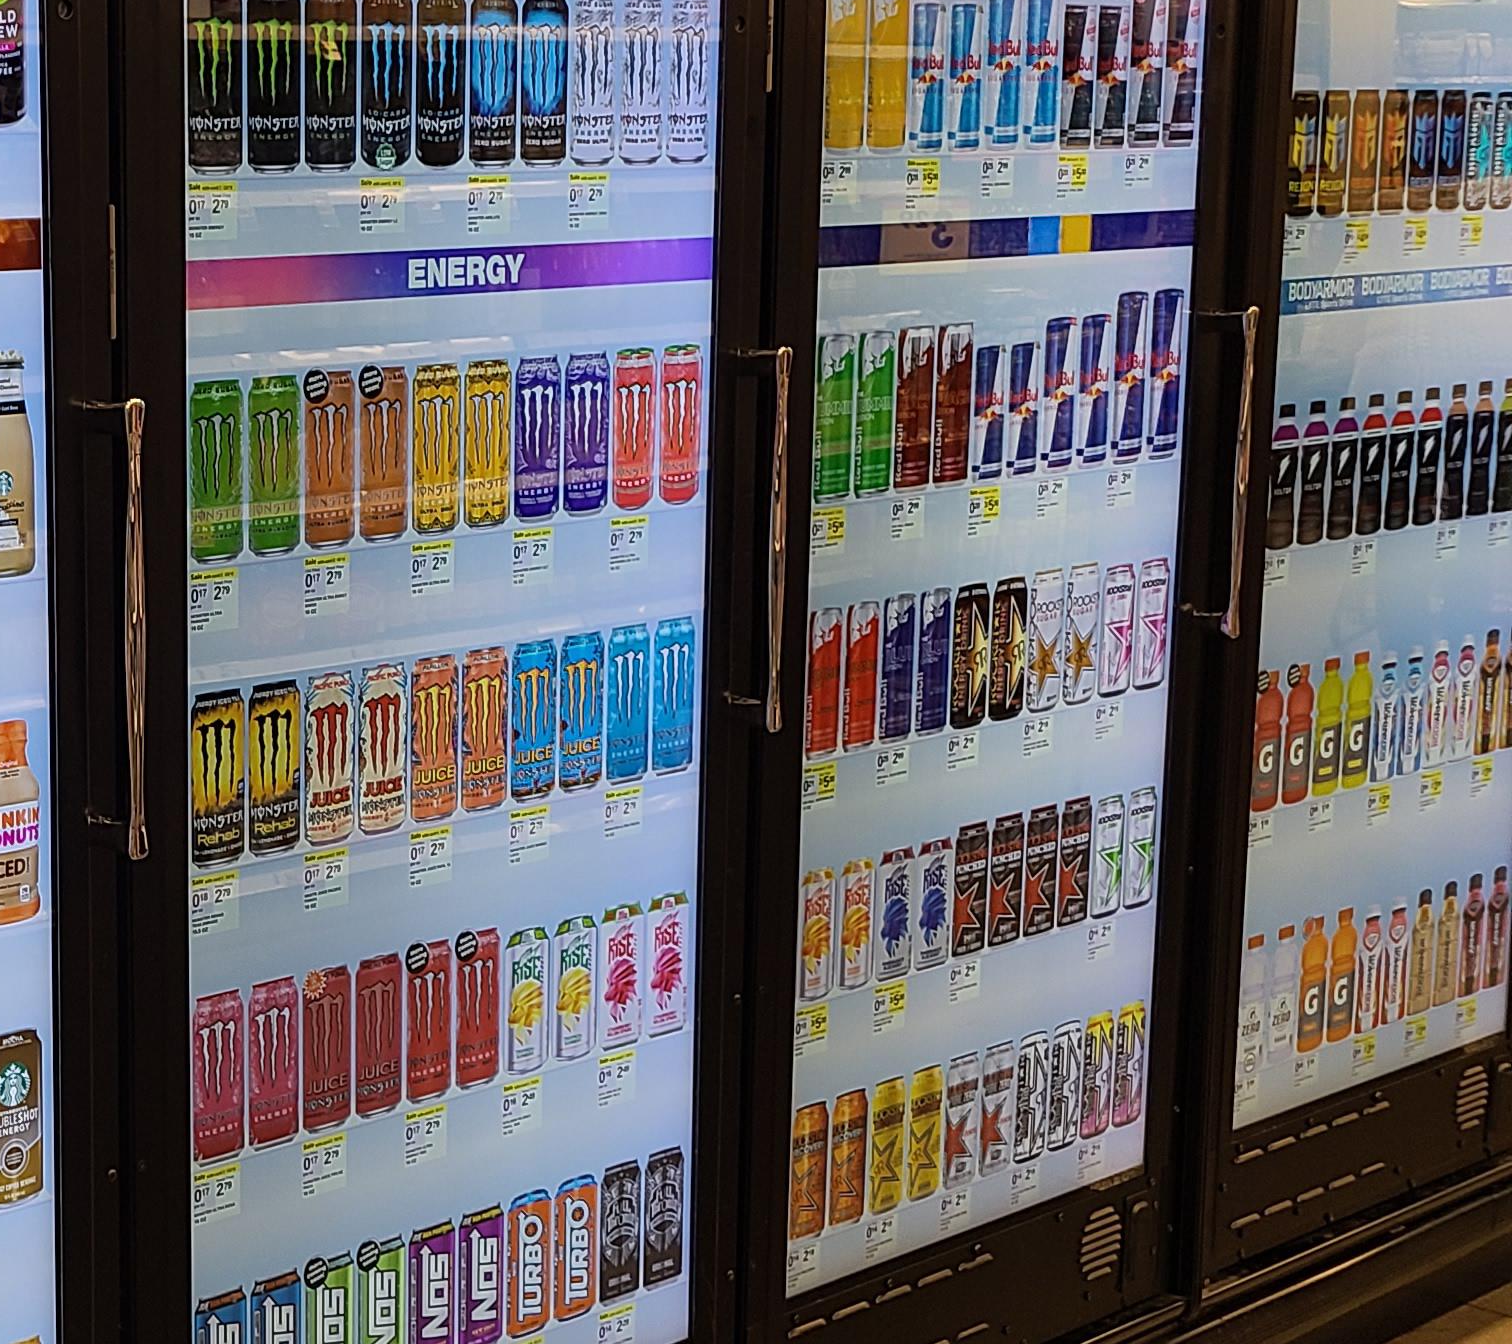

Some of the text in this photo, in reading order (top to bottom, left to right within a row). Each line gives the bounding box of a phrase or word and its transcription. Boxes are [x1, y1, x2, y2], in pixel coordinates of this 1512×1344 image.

[407, 253, 526, 290] ENERGY
[1288, 277, 1354, 302] BODYARMOR
[1361, 272, 1424, 296] BODYARMOR
[414, 765, 455, 785] JUICE
[197, 829, 241, 847] Rehab
[254, 817, 296, 837] Rehab
[564, 1196, 590, 1304] TURBO
[518, 1212, 544, 1321] TURBO
